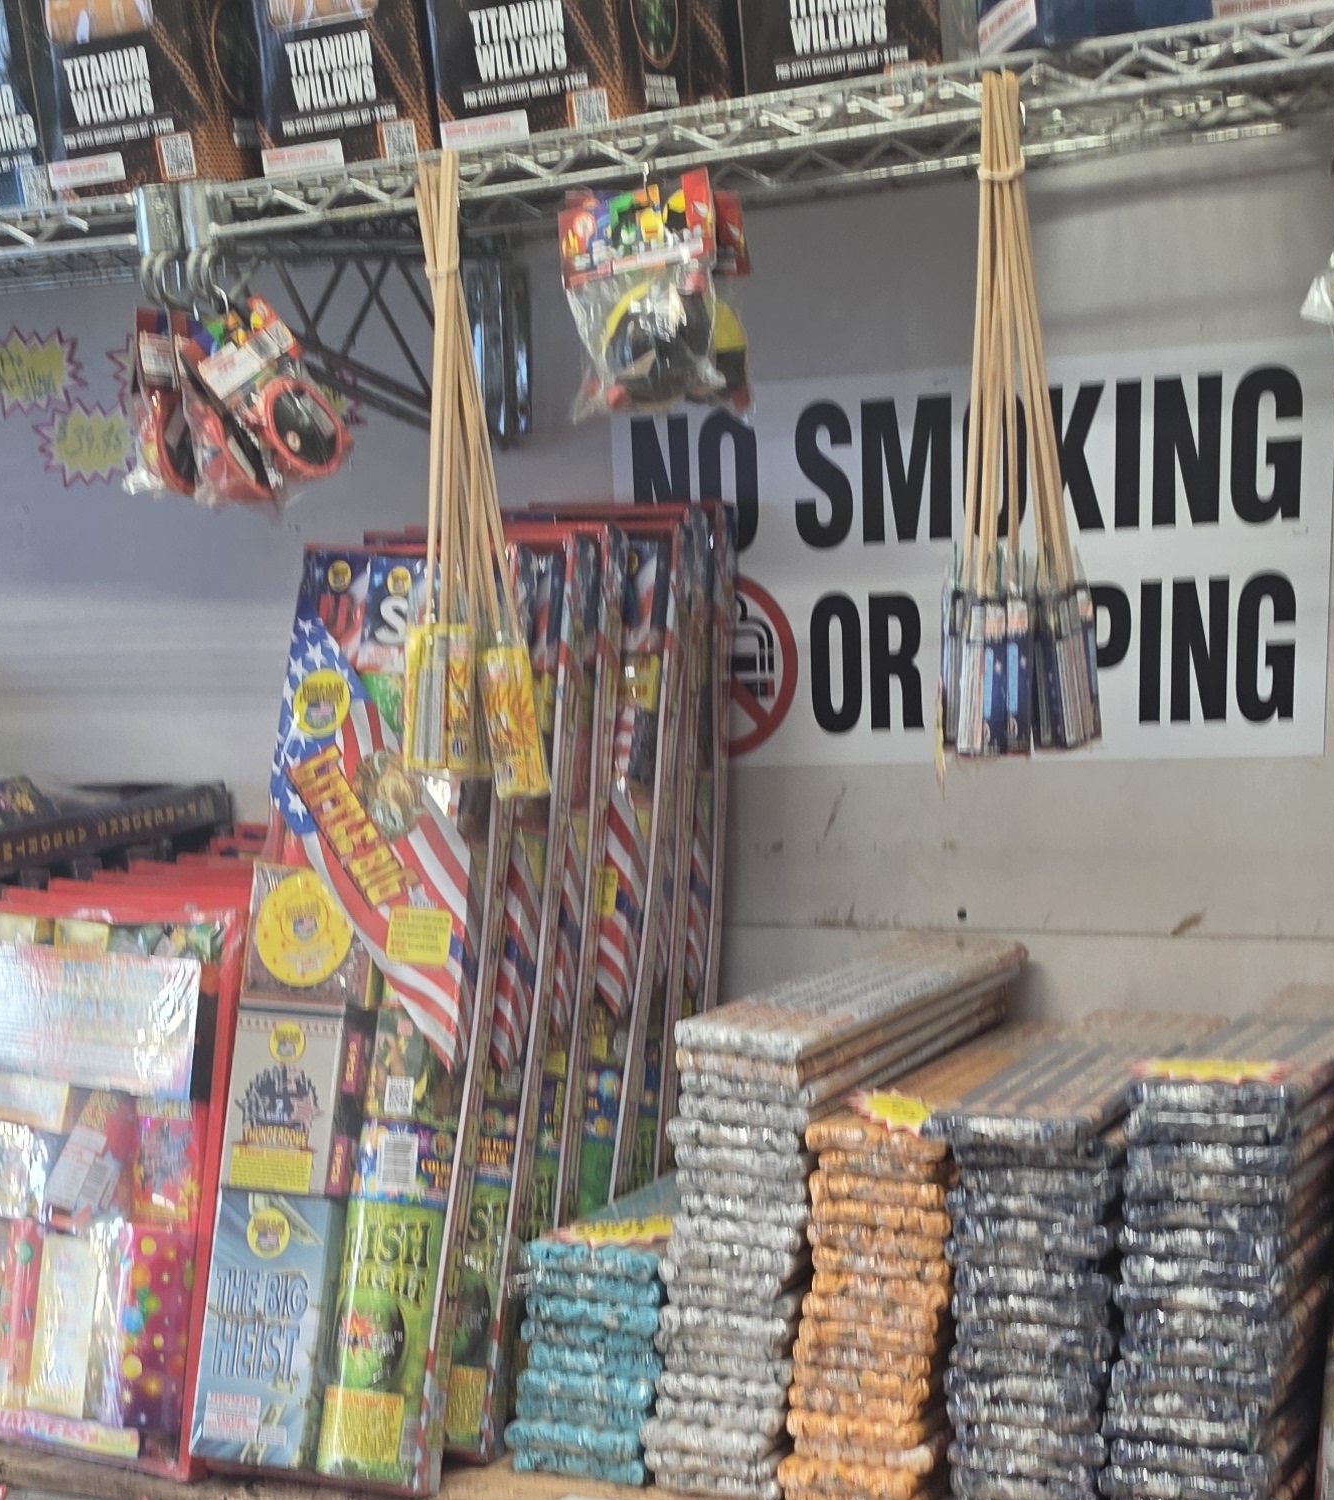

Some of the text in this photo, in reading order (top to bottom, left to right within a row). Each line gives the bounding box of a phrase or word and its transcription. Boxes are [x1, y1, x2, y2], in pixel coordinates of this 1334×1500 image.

[469, 0, 565, 46] TITANIUM
[789, 5, 887, 55] WILLOWS
[63, 45, 151, 91] TITANIUM
[285, 29, 373, 77] TITANIUM
[475, 33, 568, 83] WILLOWS
[70, 78, 155, 126] WILLOWS
[292, 65, 377, 112] WILLOWS
[631, 367, 1303, 554] NO SMOKING
[809, 571, 1297, 734] OR PING
[289, 744, 381, 858] LITTLE
[345, 843, 420, 908] BIG
[217, 1266, 309, 1321] THE BIG
[212, 1319, 301, 1383] HEIST
